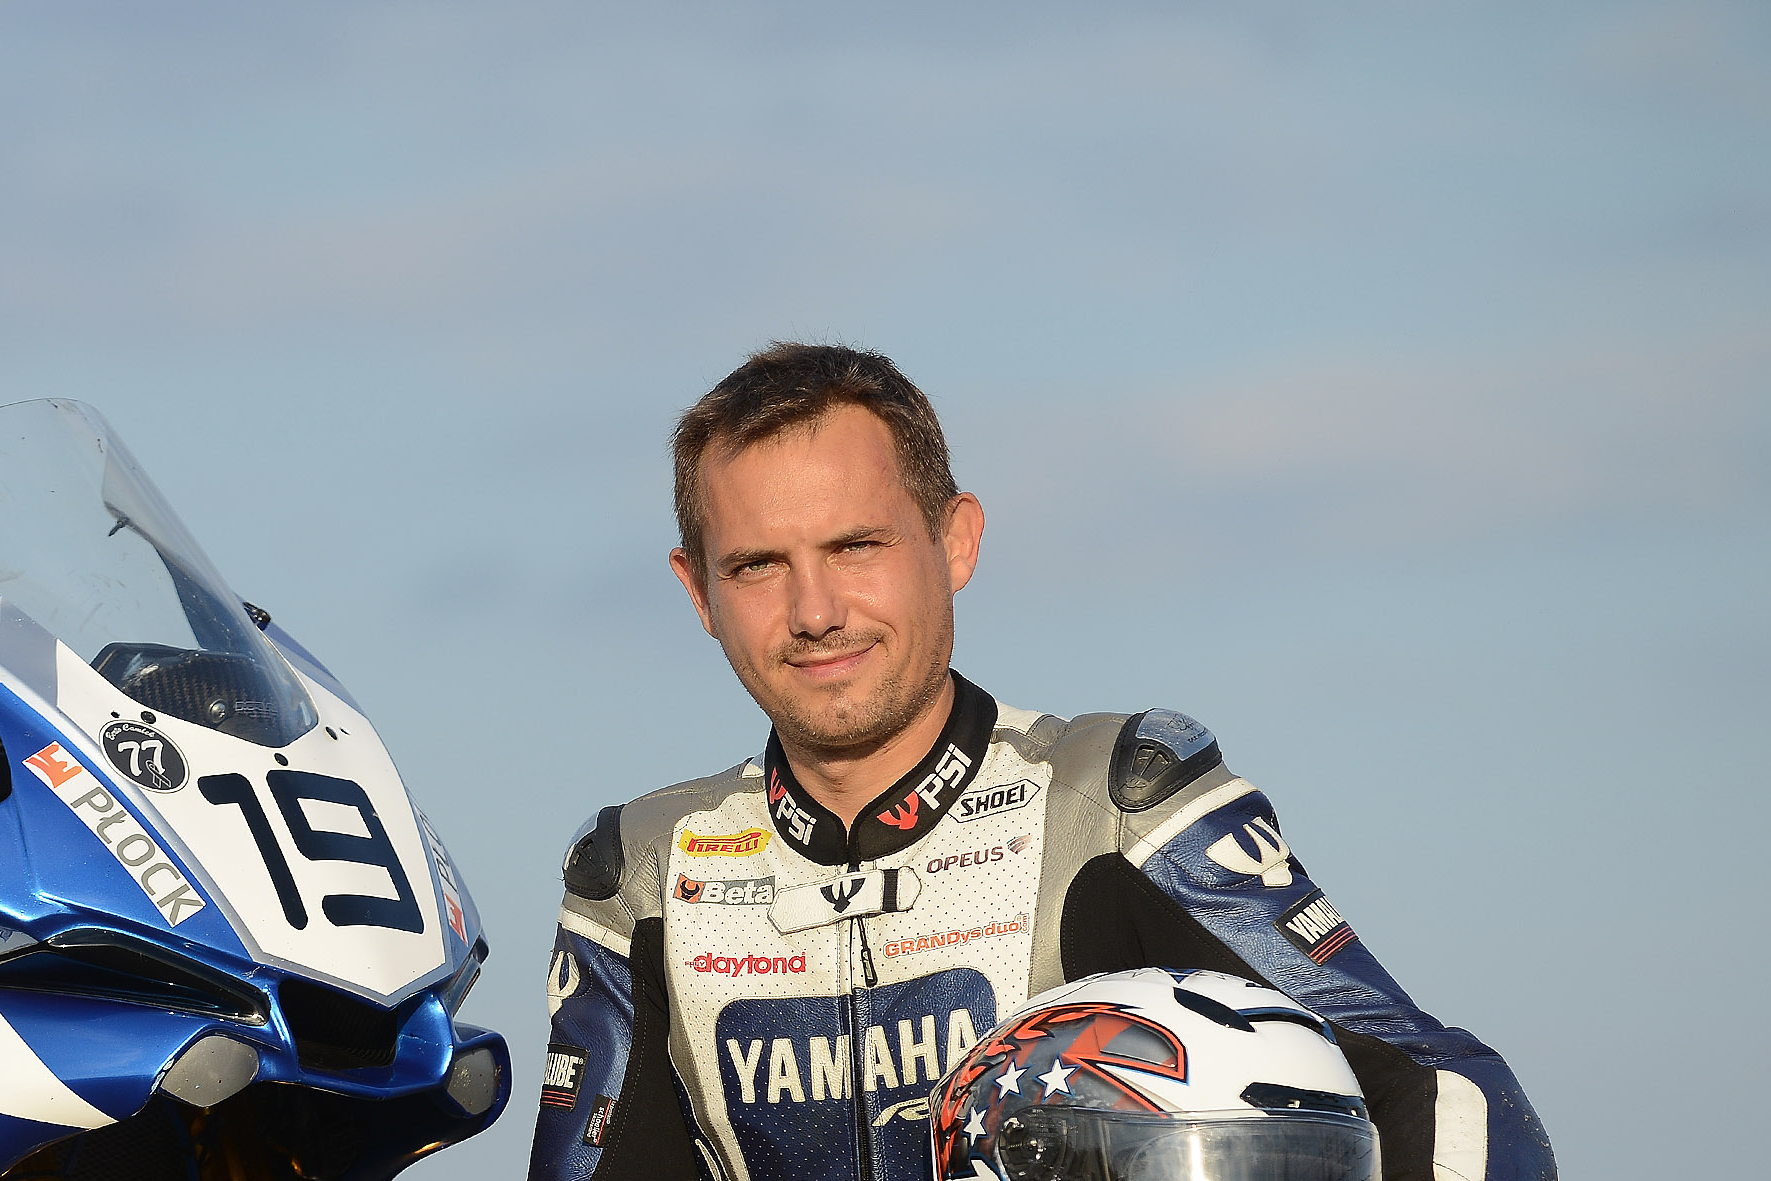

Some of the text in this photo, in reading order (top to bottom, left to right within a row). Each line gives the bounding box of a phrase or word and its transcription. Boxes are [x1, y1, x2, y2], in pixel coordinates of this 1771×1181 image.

[117, 740, 166, 777] 77
[960, 785, 1026, 817] SHOEI
[70, 787, 205, 926] PŁOCK
[197, 769, 425, 935] 19
[687, 832, 762, 853] PIRELLI
[926, 846, 1004, 873] OPEUS
[701, 881, 774, 904] Beta
[884, 929, 982, 957] GRANDys
[693, 953, 806, 977] daytona
[726, 1008, 979, 1104] YAMAHA
